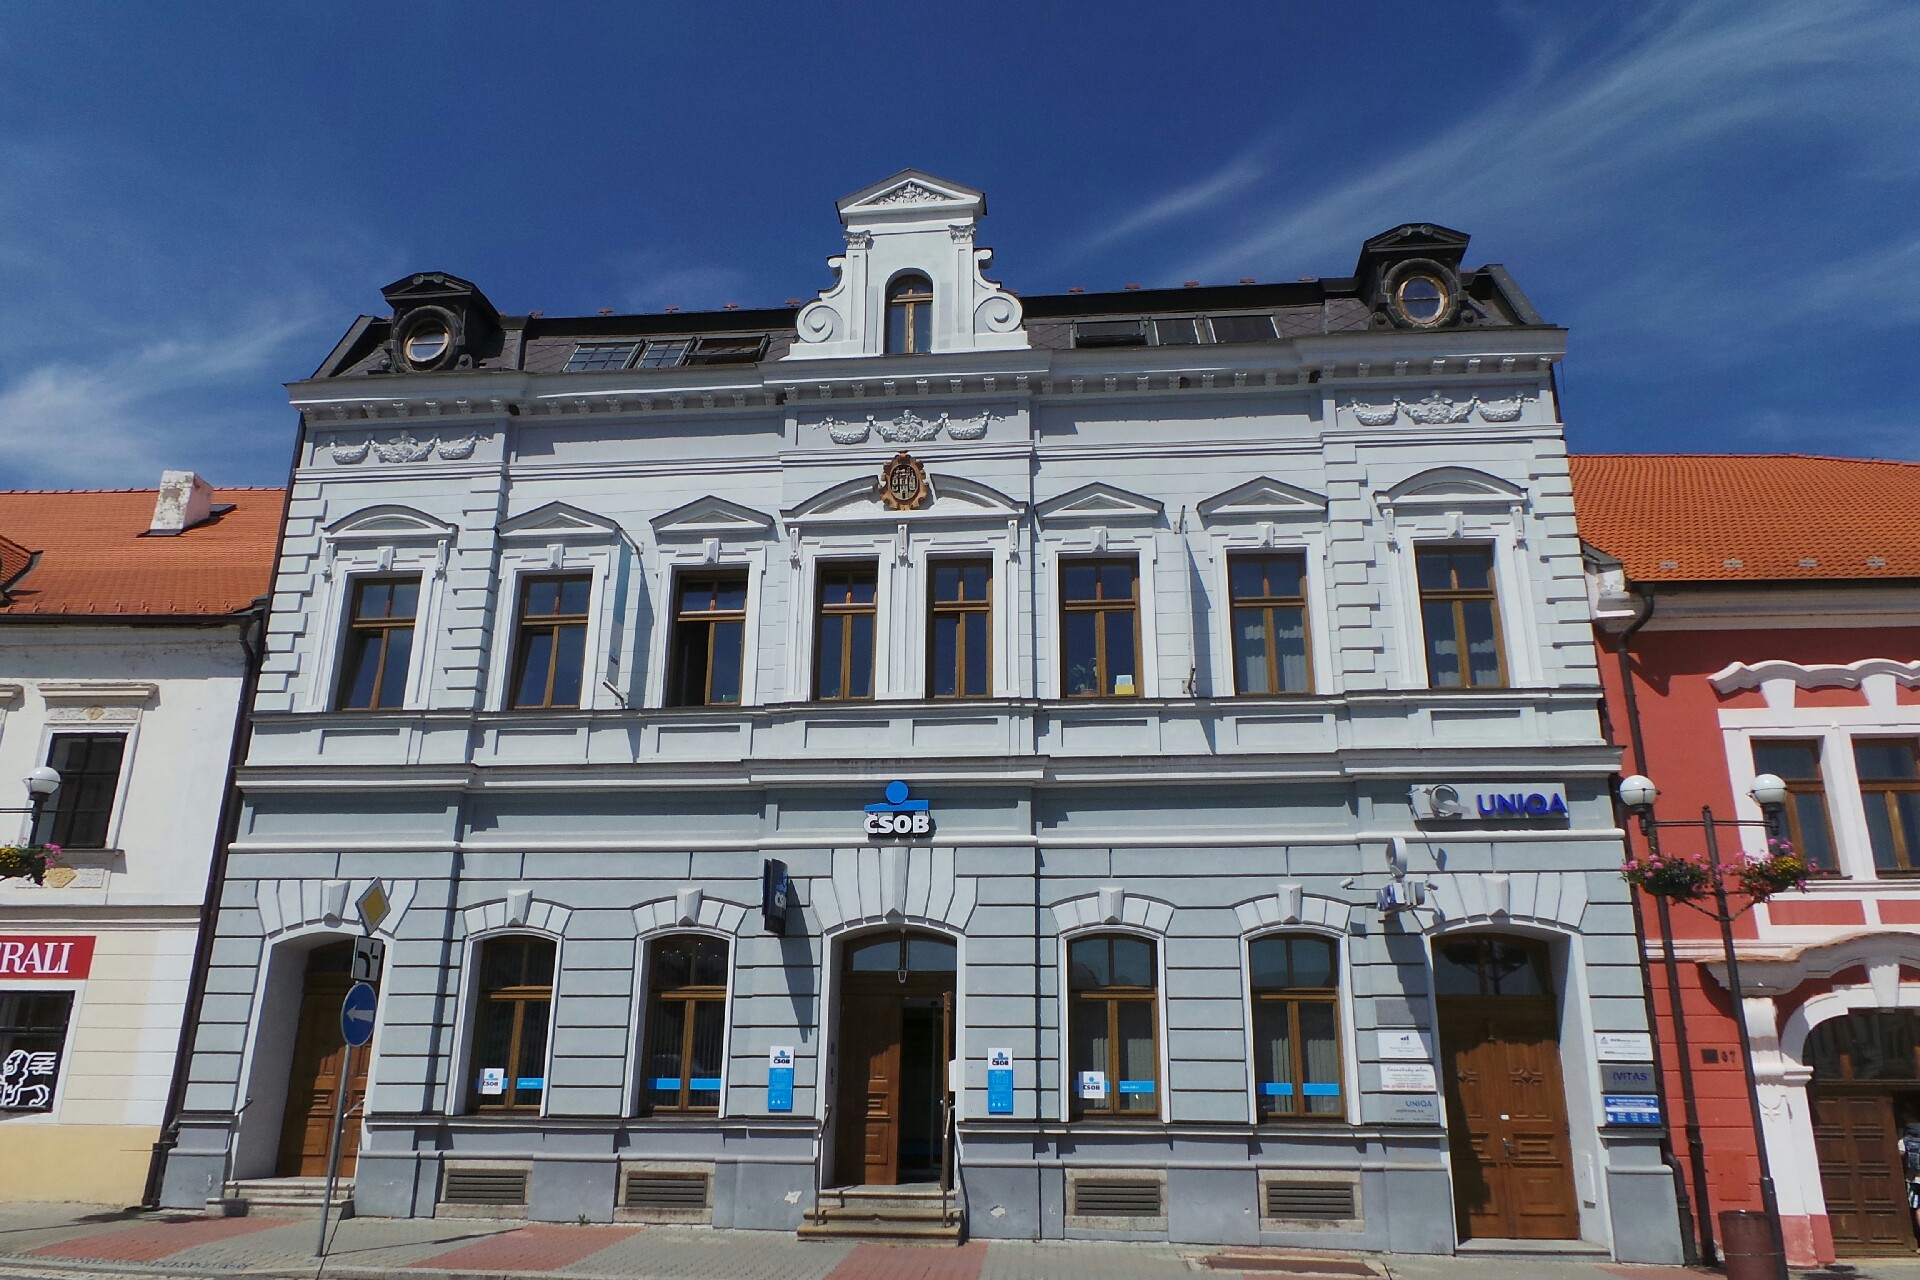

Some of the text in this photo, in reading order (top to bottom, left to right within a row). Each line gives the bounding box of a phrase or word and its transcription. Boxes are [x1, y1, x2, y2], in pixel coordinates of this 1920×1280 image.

[1476, 792, 1568, 815] UNIQA
[863, 813, 930, 834] ČSOB
[0, 942, 74, 974] RALI
